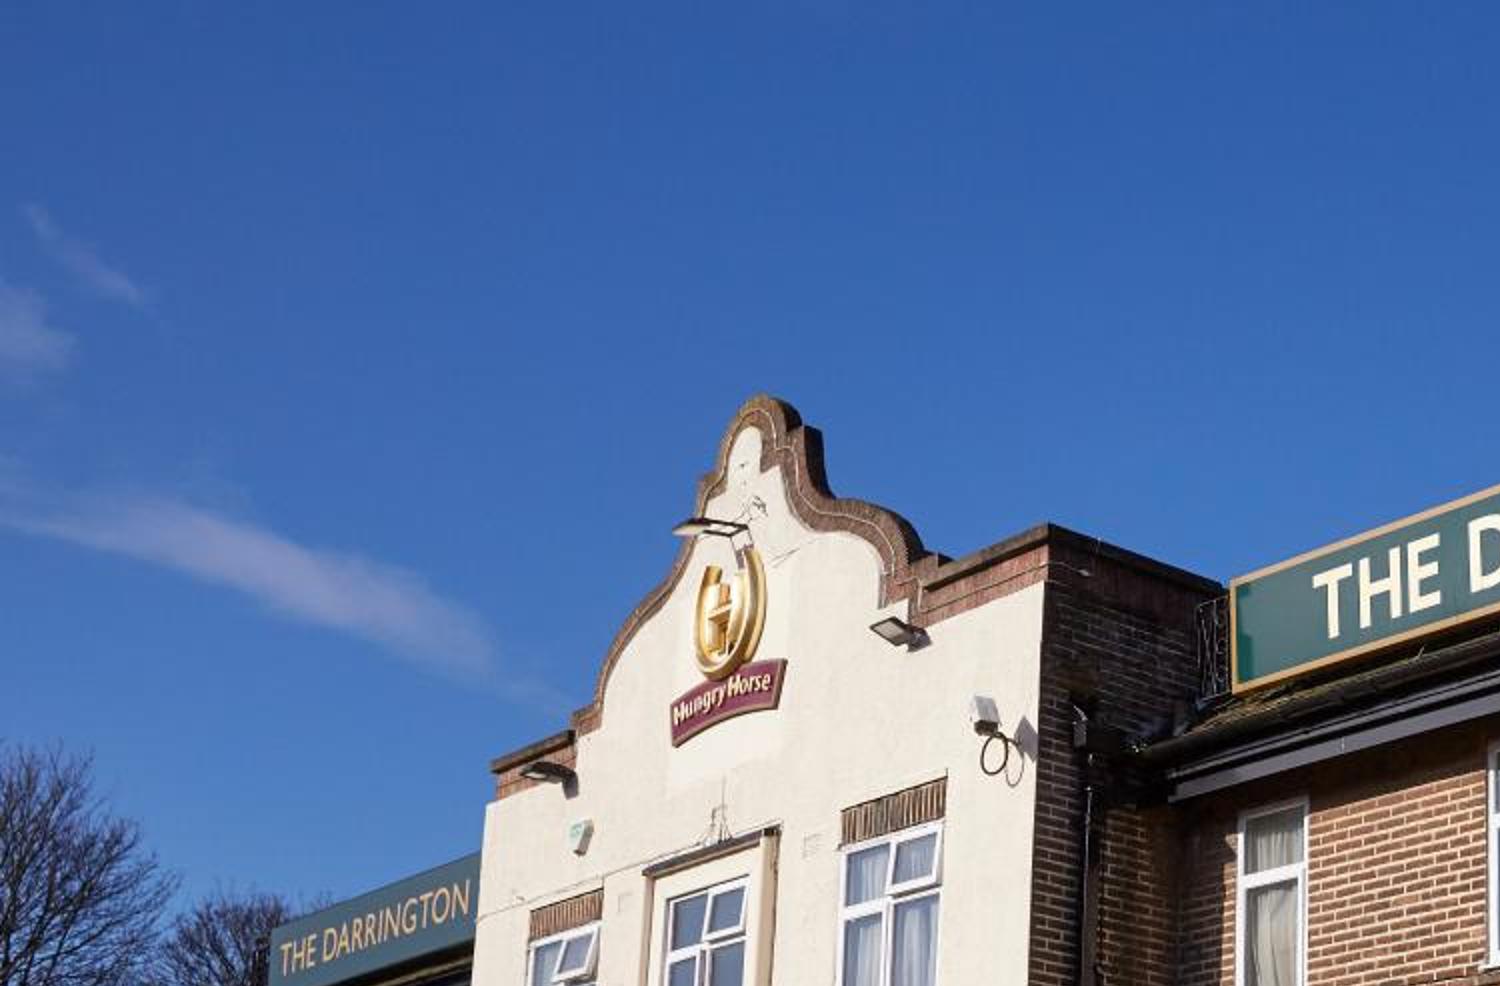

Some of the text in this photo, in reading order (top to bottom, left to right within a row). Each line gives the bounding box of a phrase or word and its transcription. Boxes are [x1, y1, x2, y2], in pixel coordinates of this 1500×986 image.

[1312, 533, 1441, 640] THE
[674, 673, 771, 725] Hungry Horse
[280, 879, 471, 977] THE DARRINGTON
